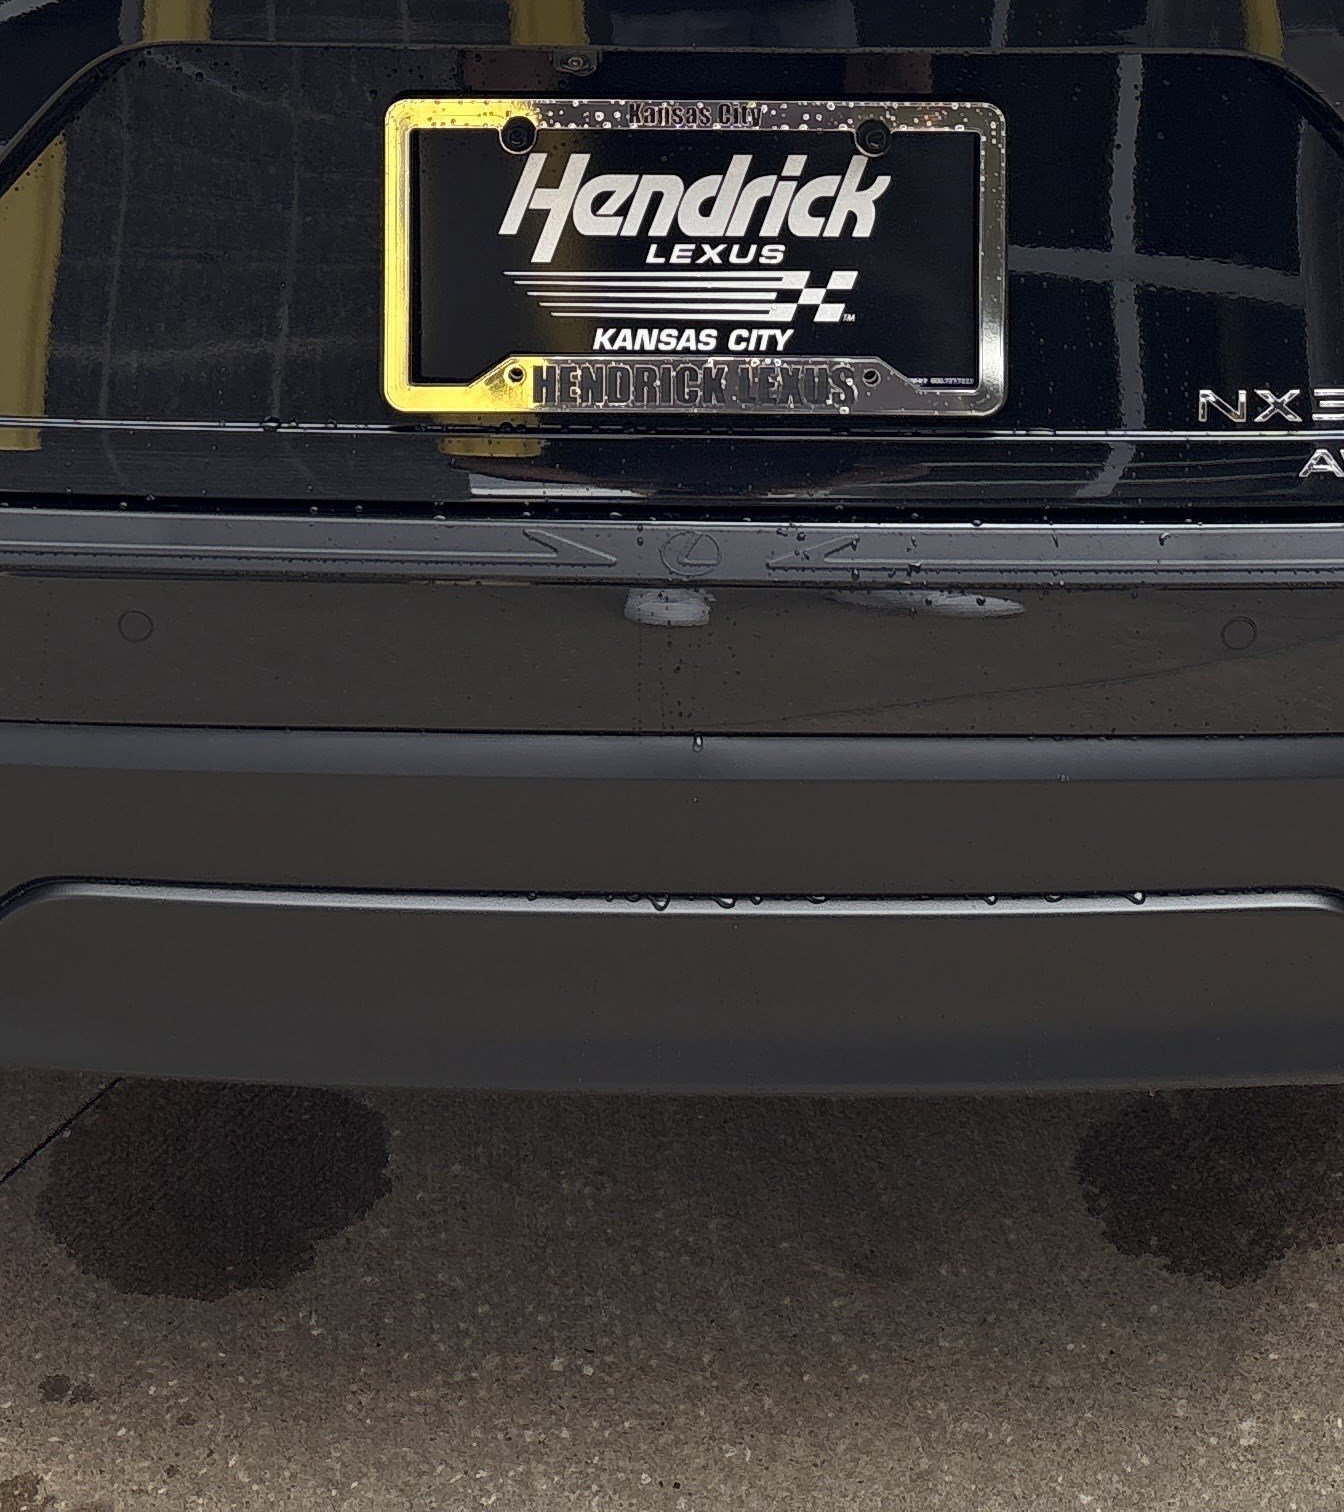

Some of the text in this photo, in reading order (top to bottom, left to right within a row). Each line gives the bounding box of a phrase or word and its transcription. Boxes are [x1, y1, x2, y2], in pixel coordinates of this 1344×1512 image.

[628, 101, 763, 128] Kansas City
[498, 152, 892, 263] Hendrick
[645, 243, 786, 264] LEXUS
[592, 327, 795, 351] KANSAS CITY
[532, 364, 858, 406] HENDRICK LEXUS
